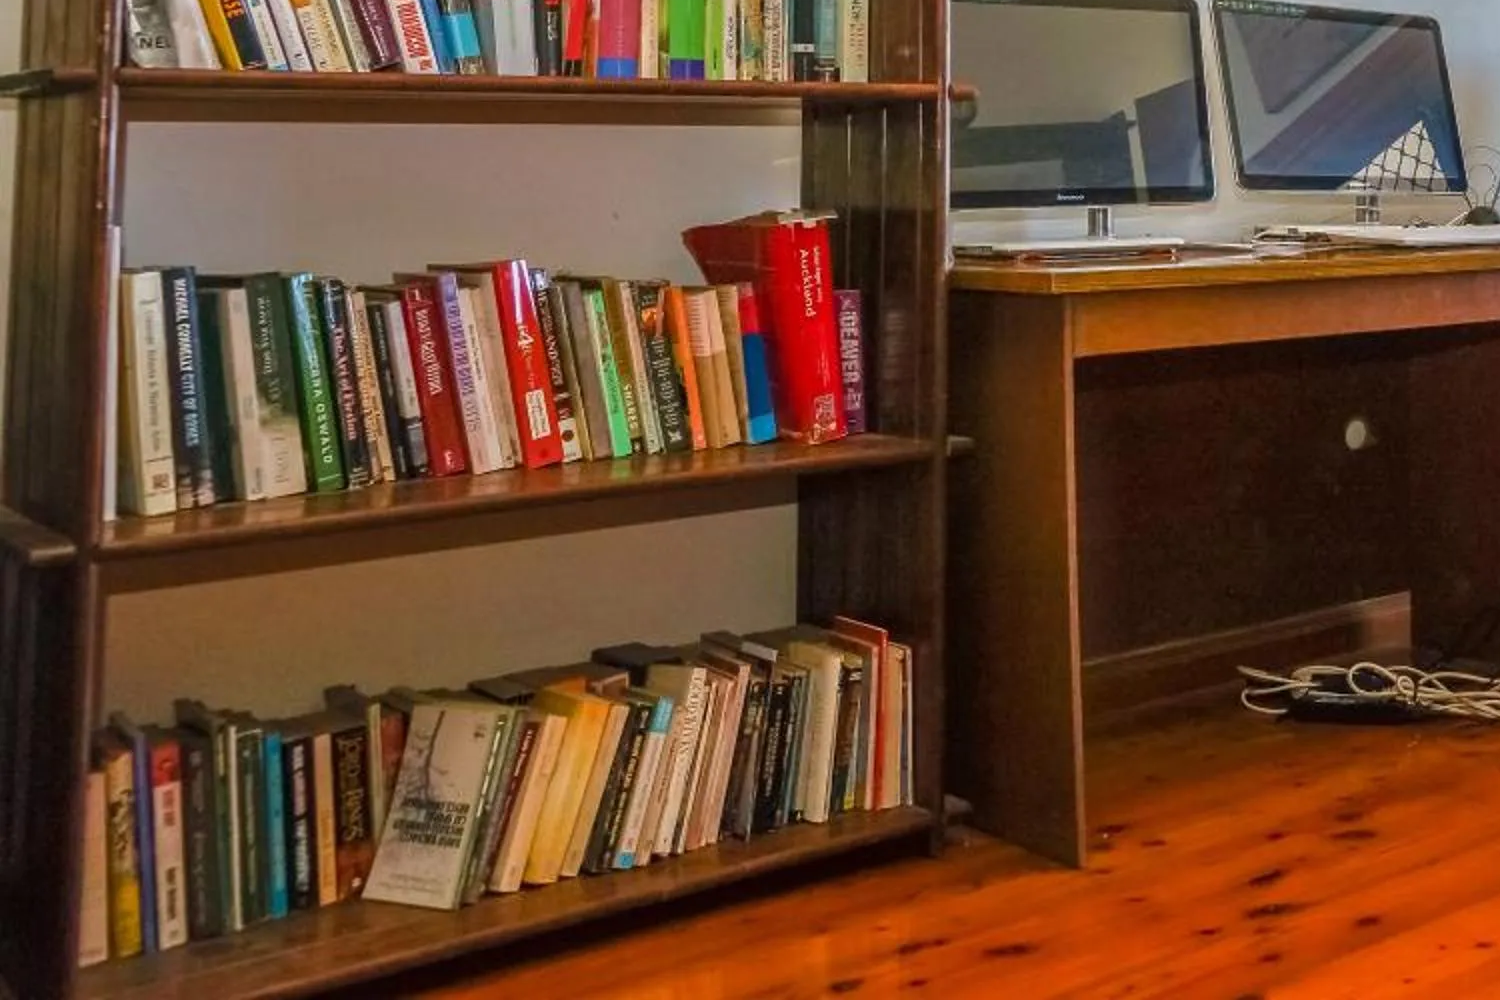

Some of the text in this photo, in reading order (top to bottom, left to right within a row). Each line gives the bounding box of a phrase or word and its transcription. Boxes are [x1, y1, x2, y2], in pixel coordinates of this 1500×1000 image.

[800, 249, 817, 318] Auckland
[181, 373, 196, 395] CITY
[624, 384, 639, 428] SHARES
[316, 403, 334, 464] OSWALD
